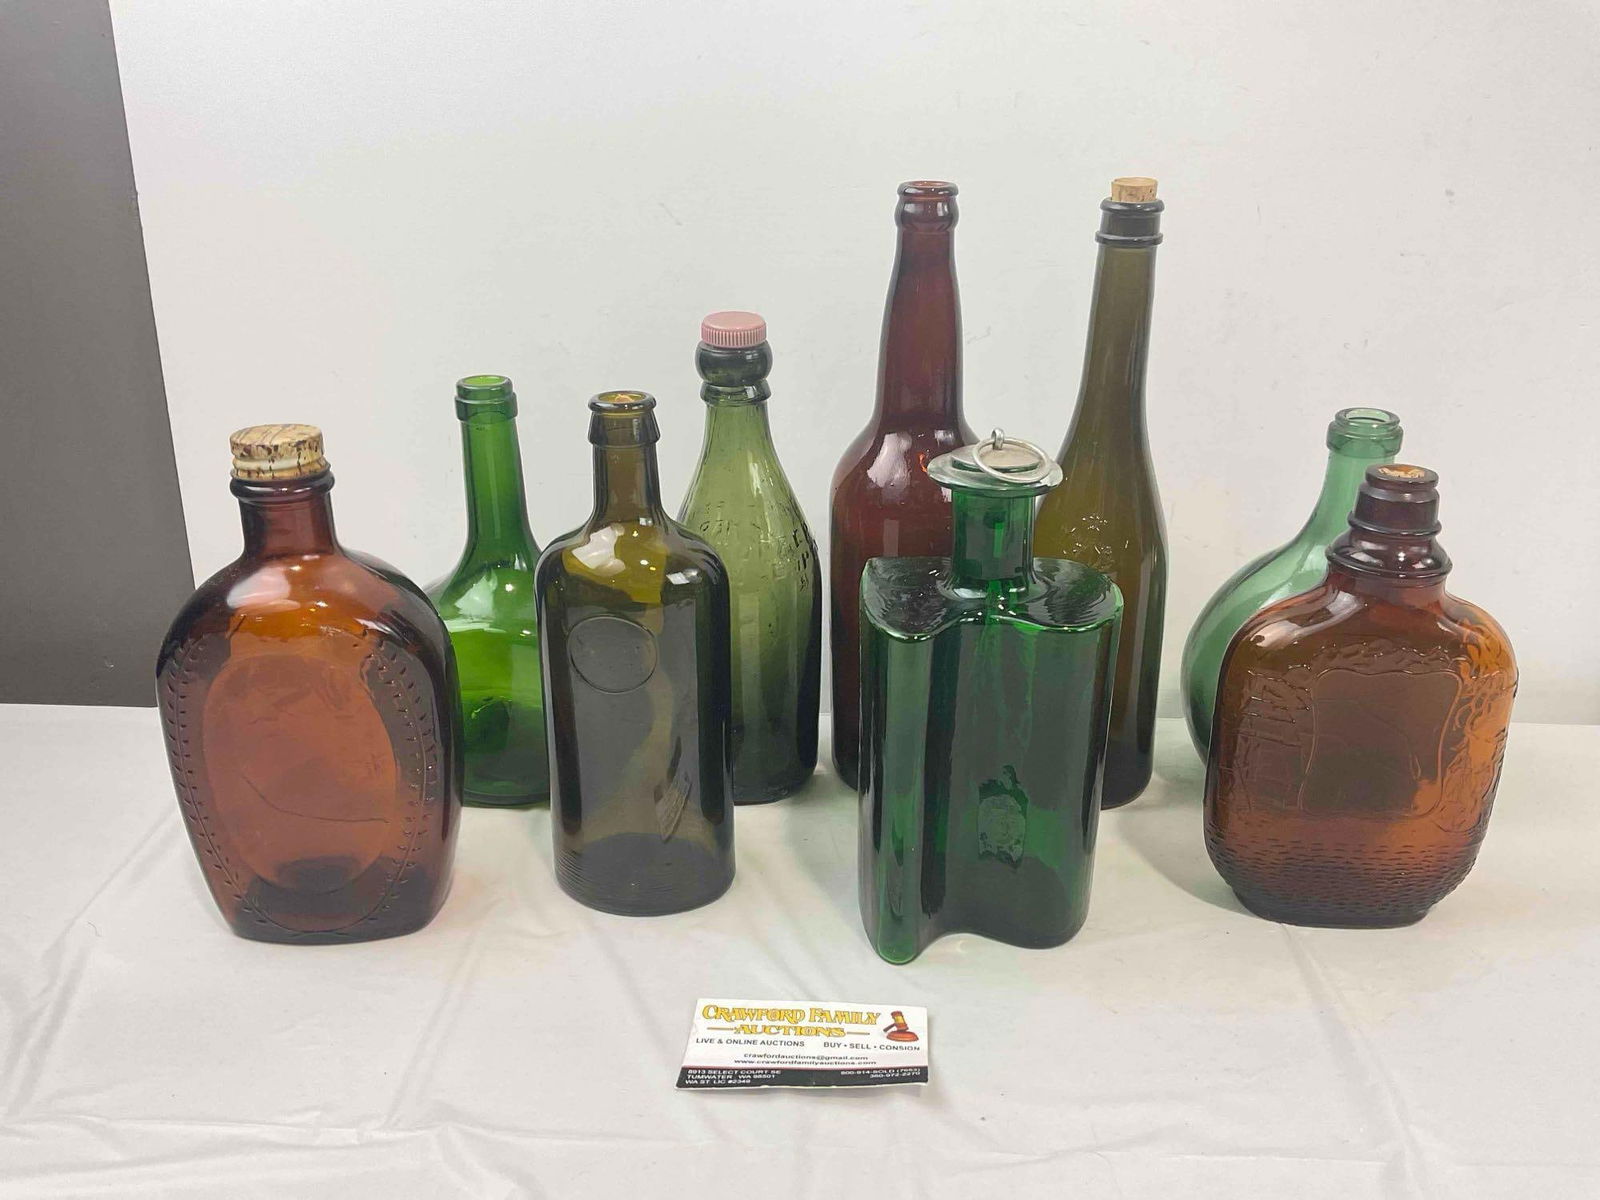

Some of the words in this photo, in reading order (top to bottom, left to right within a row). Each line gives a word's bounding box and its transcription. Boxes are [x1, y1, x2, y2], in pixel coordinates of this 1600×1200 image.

[702, 1004, 806, 1025] CRAWFORD
[808, 1007, 881, 1025] FAMILY
[734, 1024, 846, 1038] AUCTIONS
[743, 1053, 868, 1061] crawfordauctions@gmail.com
